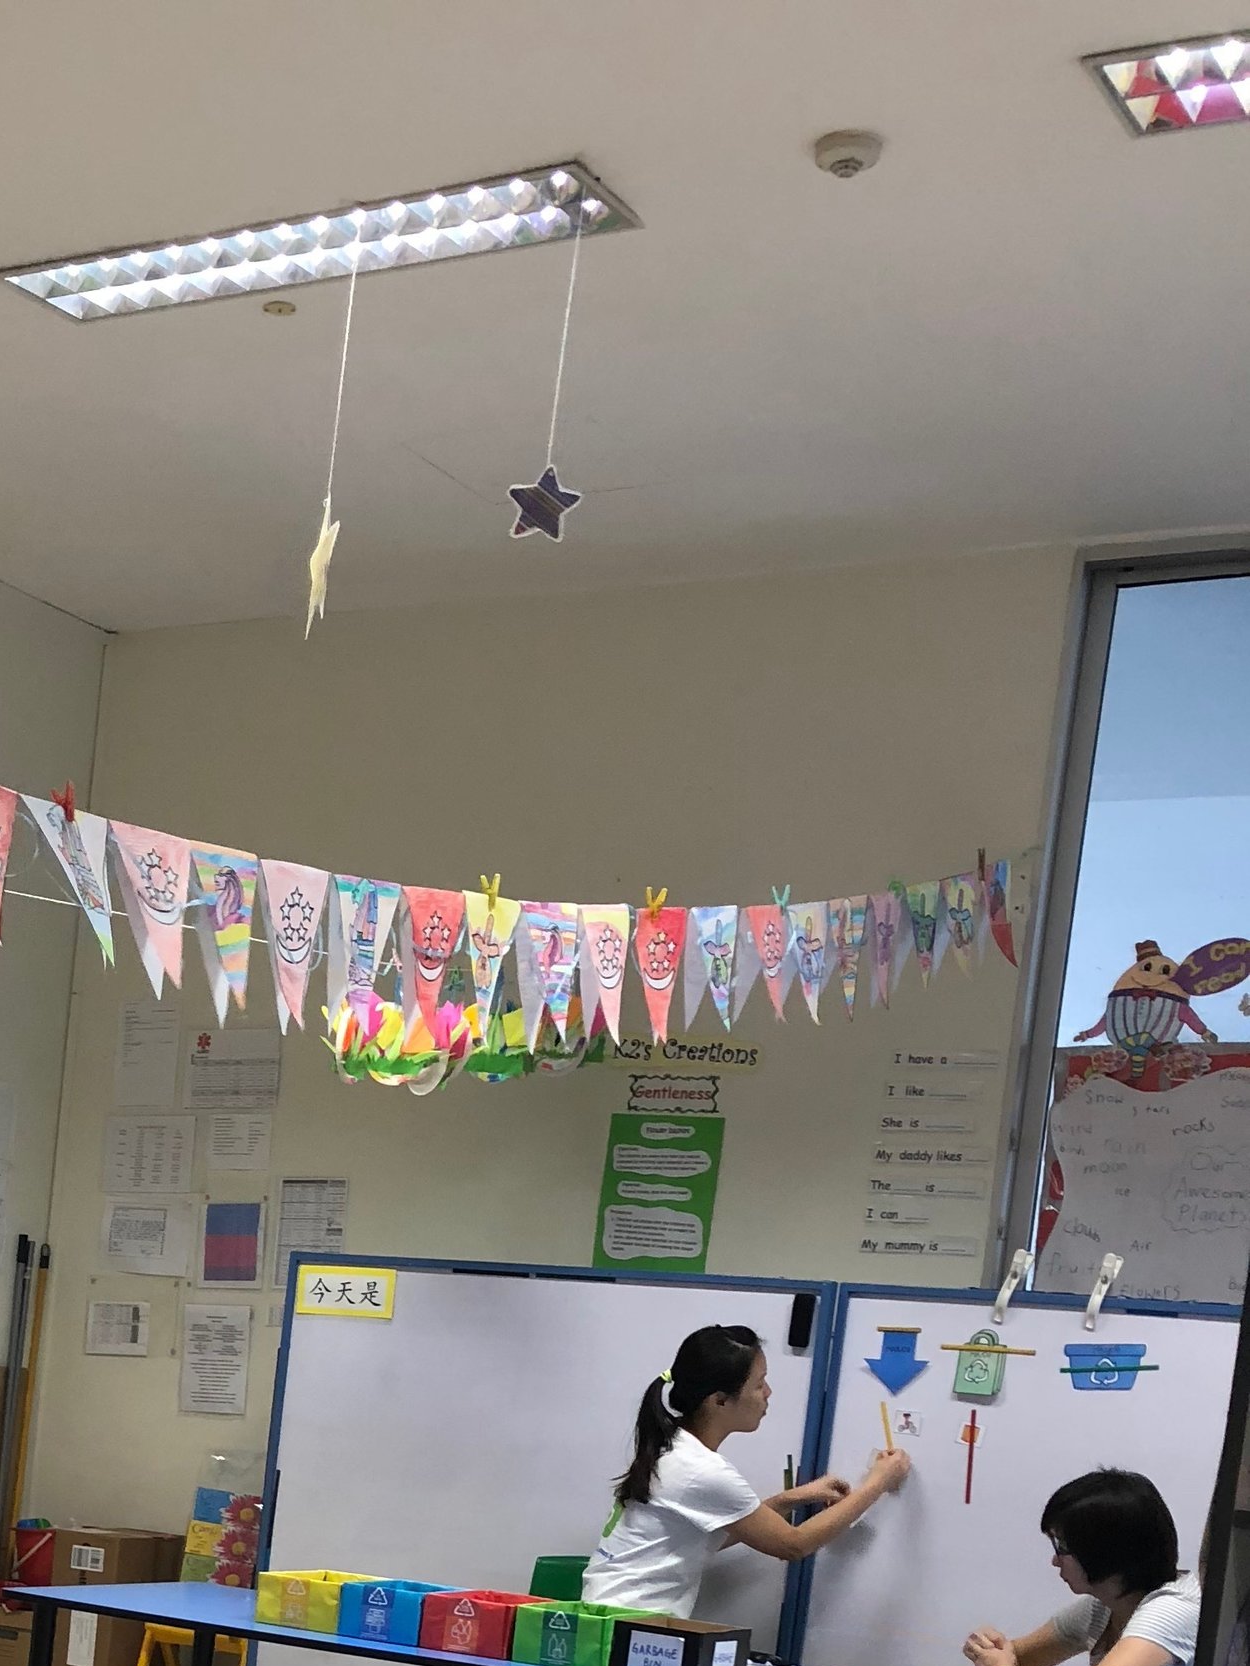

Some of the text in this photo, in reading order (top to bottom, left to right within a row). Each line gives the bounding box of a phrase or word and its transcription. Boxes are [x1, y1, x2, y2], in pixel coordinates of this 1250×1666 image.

[1194, 962, 1246, 994] read
[614, 1038, 758, 1066] K2's Creations
[894, 1054, 947, 1064] I have a
[634, 1086, 711, 1100] Gentleness
[888, 1086, 925, 1096] I like
[881, 1118, 919, 1128] She is
[1172, 1118, 1215, 1136] rocks
[875, 1150, 962, 1163] My daddy likes
[871, 1180, 935, 1193] The is
[866, 1209, 898, 1219] I can
[861, 1239, 938, 1253] My mummy is
[309, 1278, 382, 1307] 今天是
[632, 1642, 678, 1660] GARBAGE
